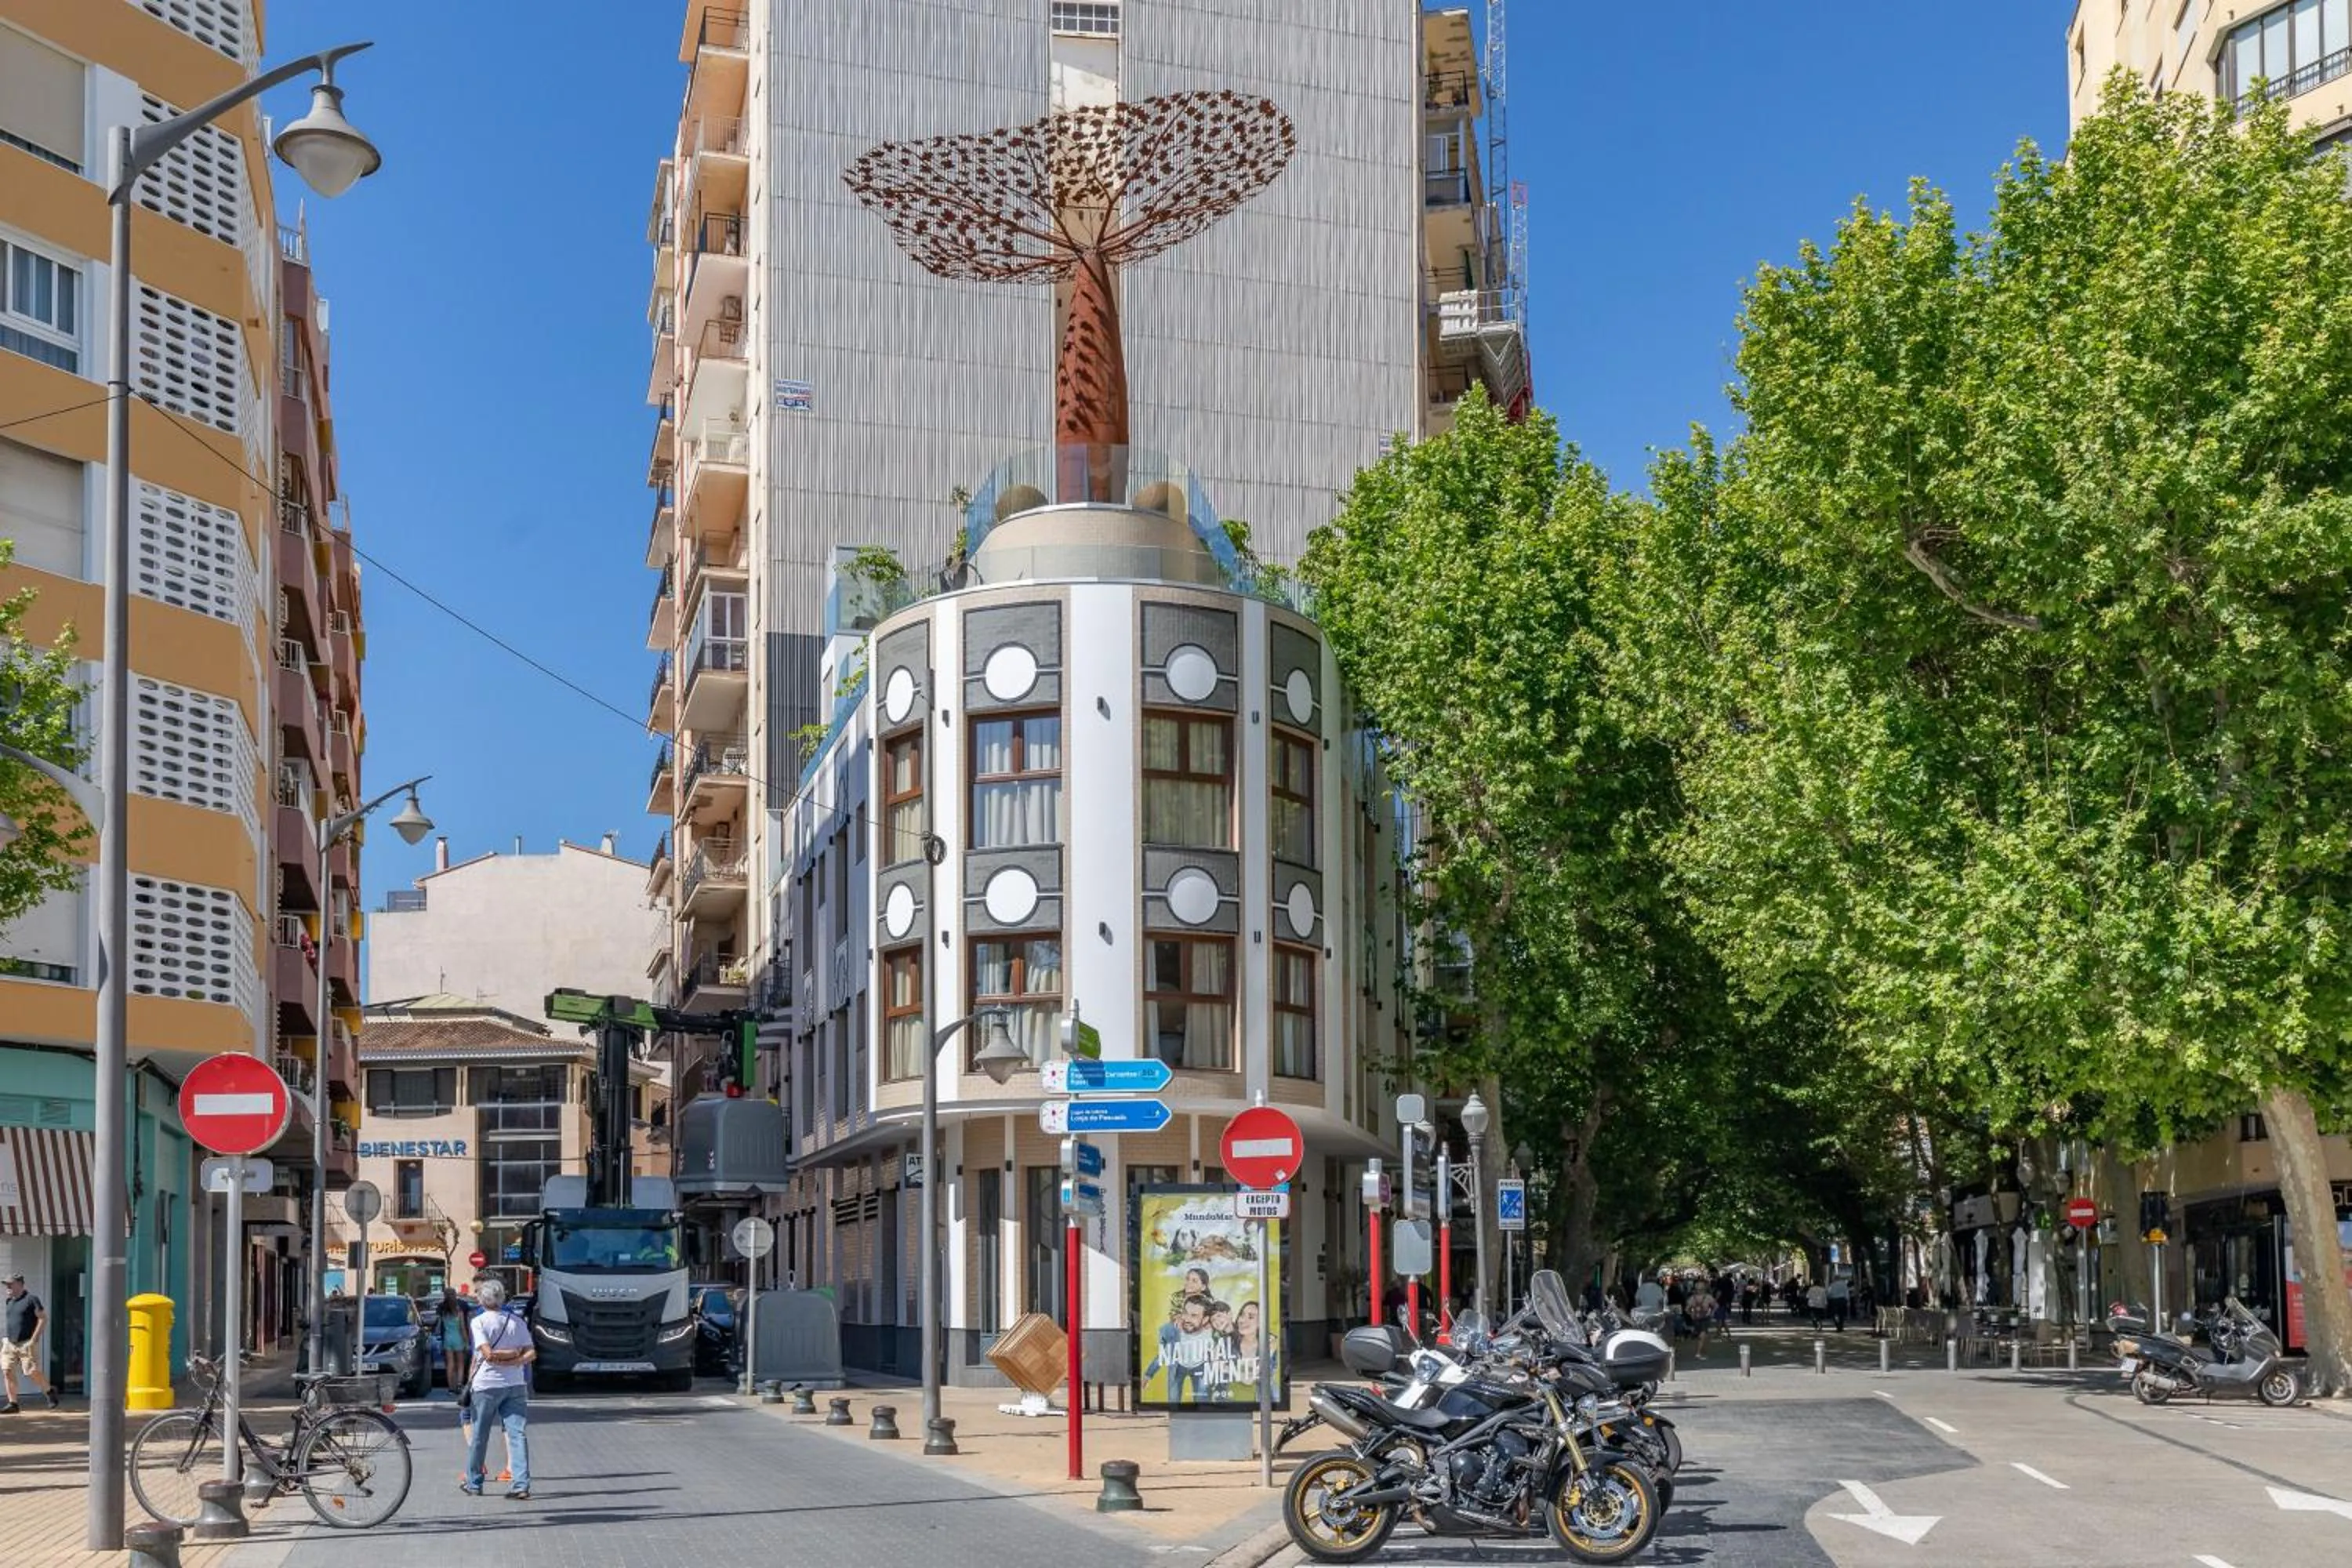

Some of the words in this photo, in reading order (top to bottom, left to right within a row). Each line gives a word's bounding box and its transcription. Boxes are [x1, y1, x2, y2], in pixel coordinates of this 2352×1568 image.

[359, 1140, 466, 1158] BIENESTAR
[1246, 1194, 1280, 1204] EXCEPTO
[1249, 1207, 1278, 1216] MOTOS
[1158, 1336, 1236, 1367] NATURAL
